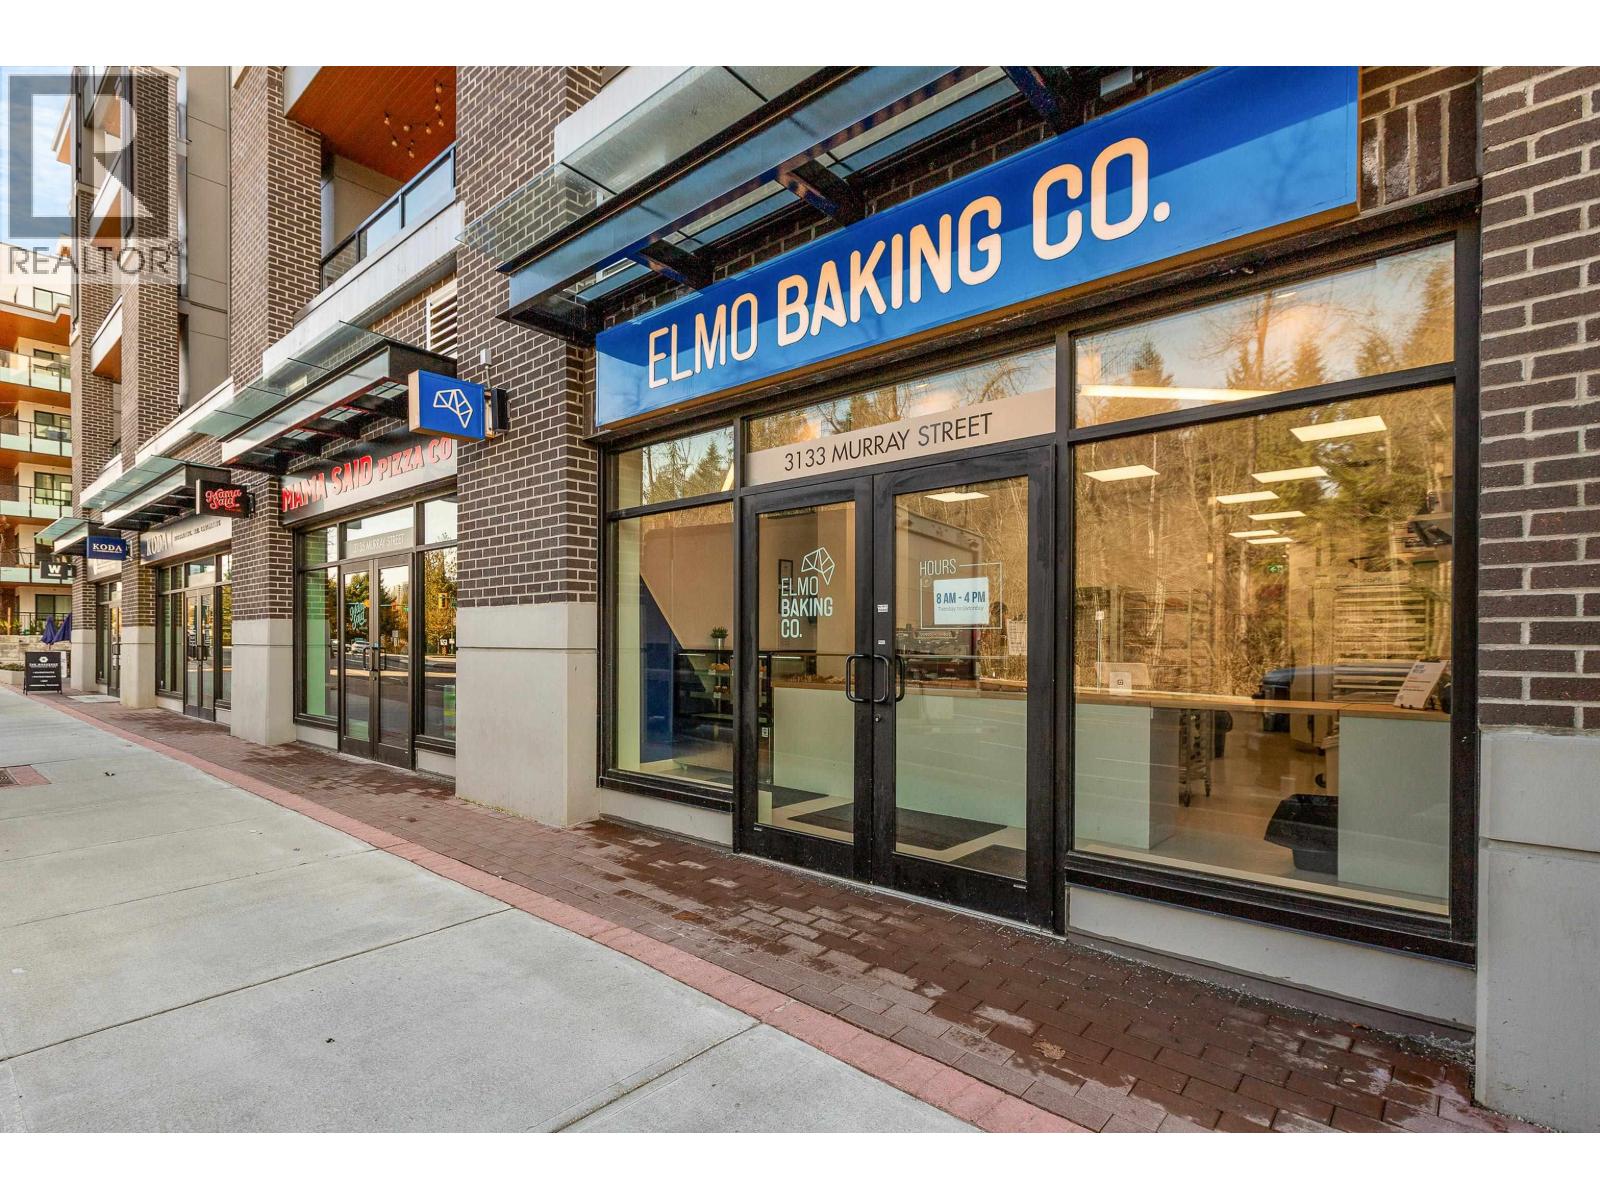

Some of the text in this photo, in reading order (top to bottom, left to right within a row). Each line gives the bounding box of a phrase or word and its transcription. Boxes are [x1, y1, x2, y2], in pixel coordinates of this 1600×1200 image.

[647, 136, 1171, 390] ELMO BAKING CO.
[784, 412, 993, 472] 3133 MURRAY STREET
[281, 472, 329, 513] MAMA
[330, 454, 374, 496] SAID
[377, 444, 425, 482] PIZZA
[205, 488, 243, 503] Mama
[92, 543, 123, 552] KODA
[147, 530, 169, 557] KODA
[48, 564, 62, 574] W
[919, 558, 957, 577] HOURS
[781, 576, 819, 597] ELMO
[781, 596, 833, 618] BAKING
[936, 592, 942, 604] 8
[943, 592, 957, 604] AM
[964, 591, 970, 603] 4
[972, 591, 986, 603] PM
[781, 618, 803, 638] CO.
